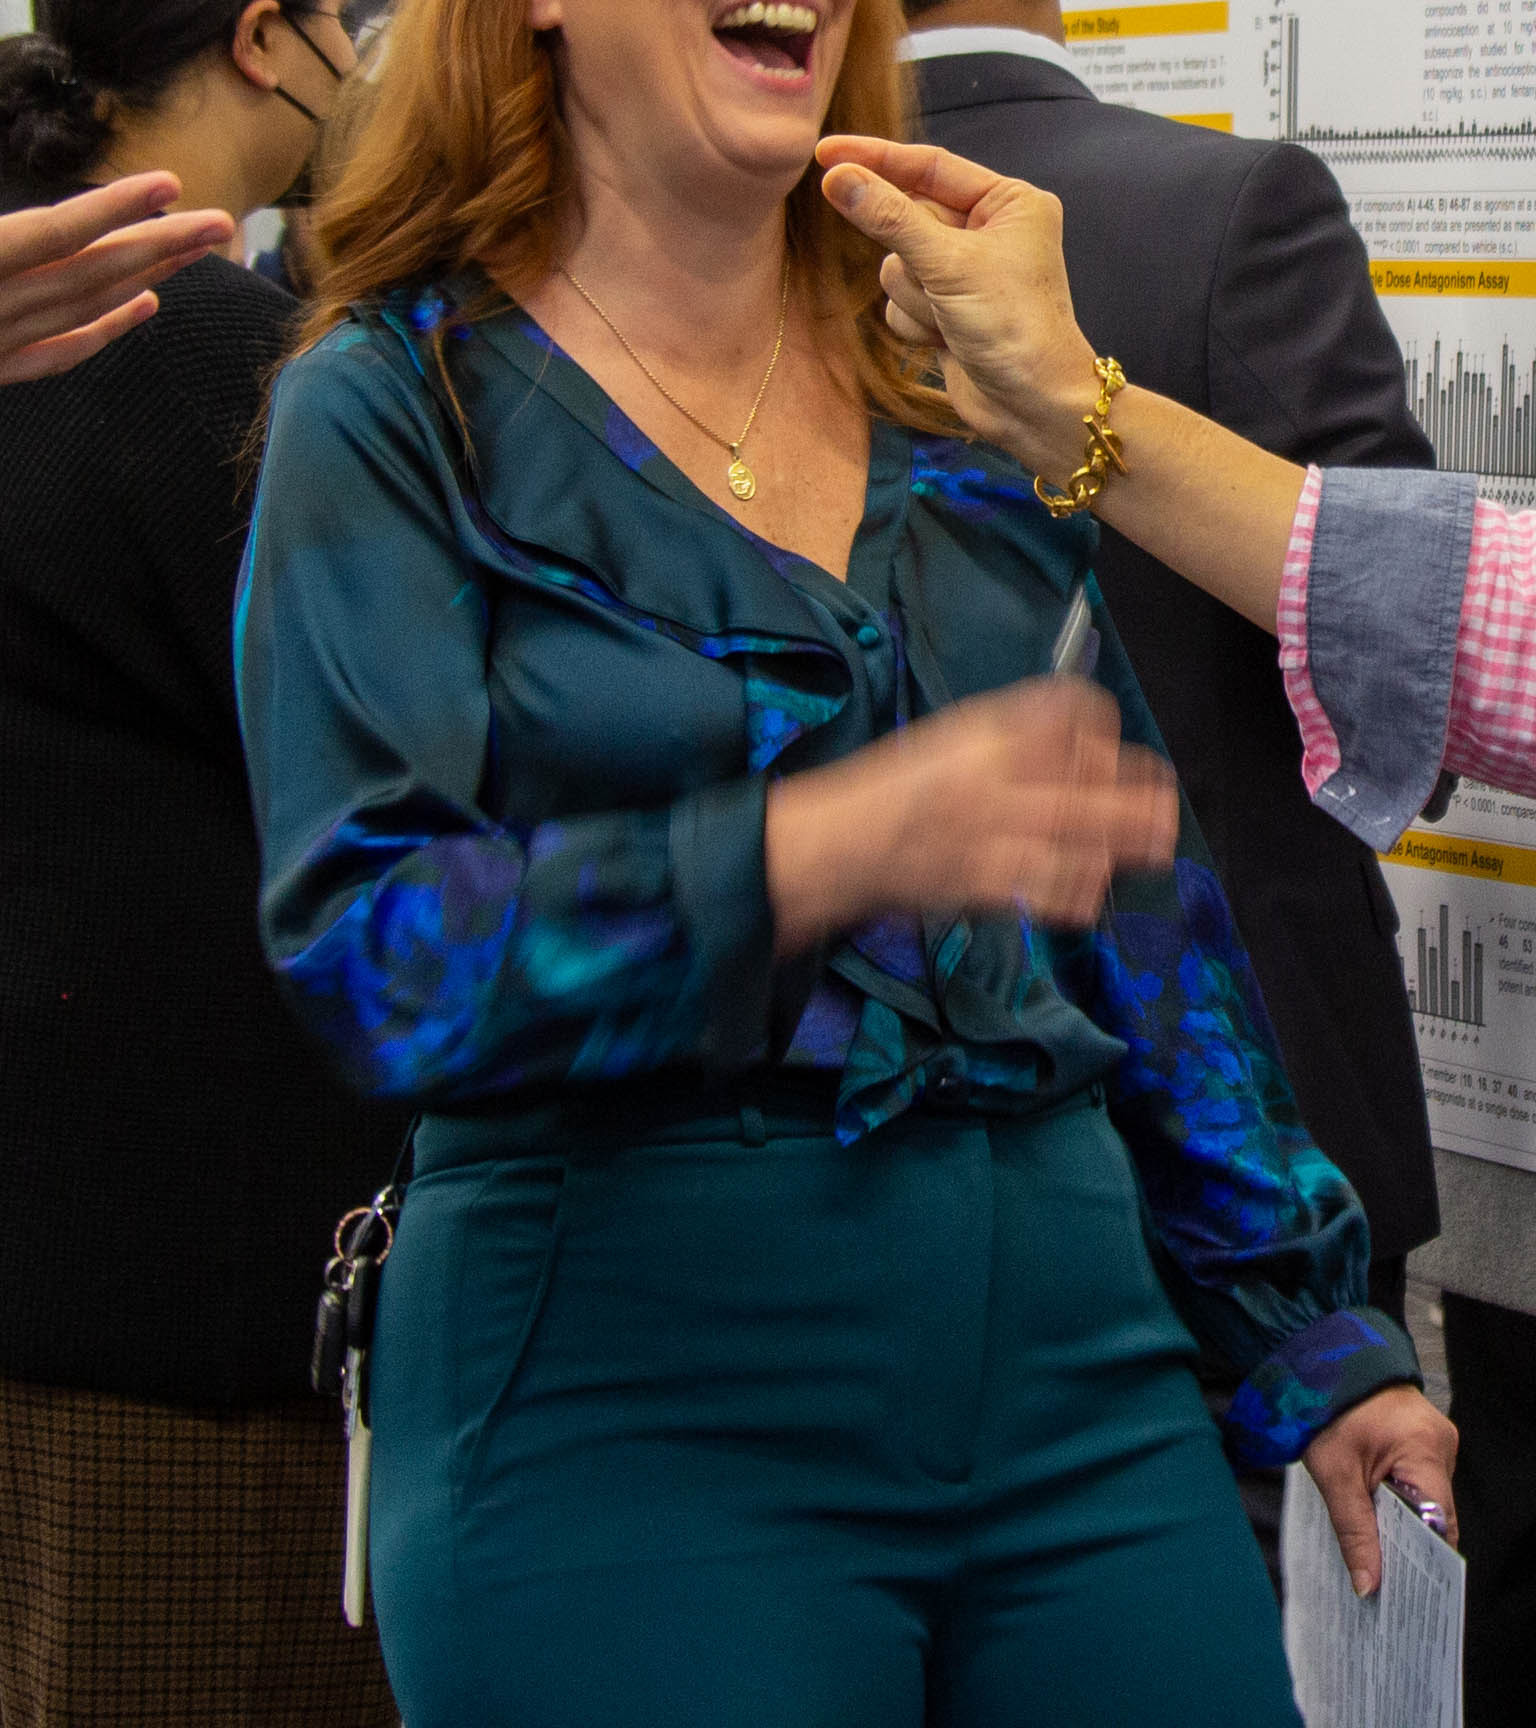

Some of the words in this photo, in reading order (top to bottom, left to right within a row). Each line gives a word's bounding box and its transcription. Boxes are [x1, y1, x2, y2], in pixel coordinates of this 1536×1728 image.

[1385, 269, 1411, 288] Dose
[1413, 269, 1475, 293] Antagonism
[1477, 270, 1509, 293] Assay
[1405, 840, 1467, 866] Antagonism
[1469, 849, 1504, 875] Assay
